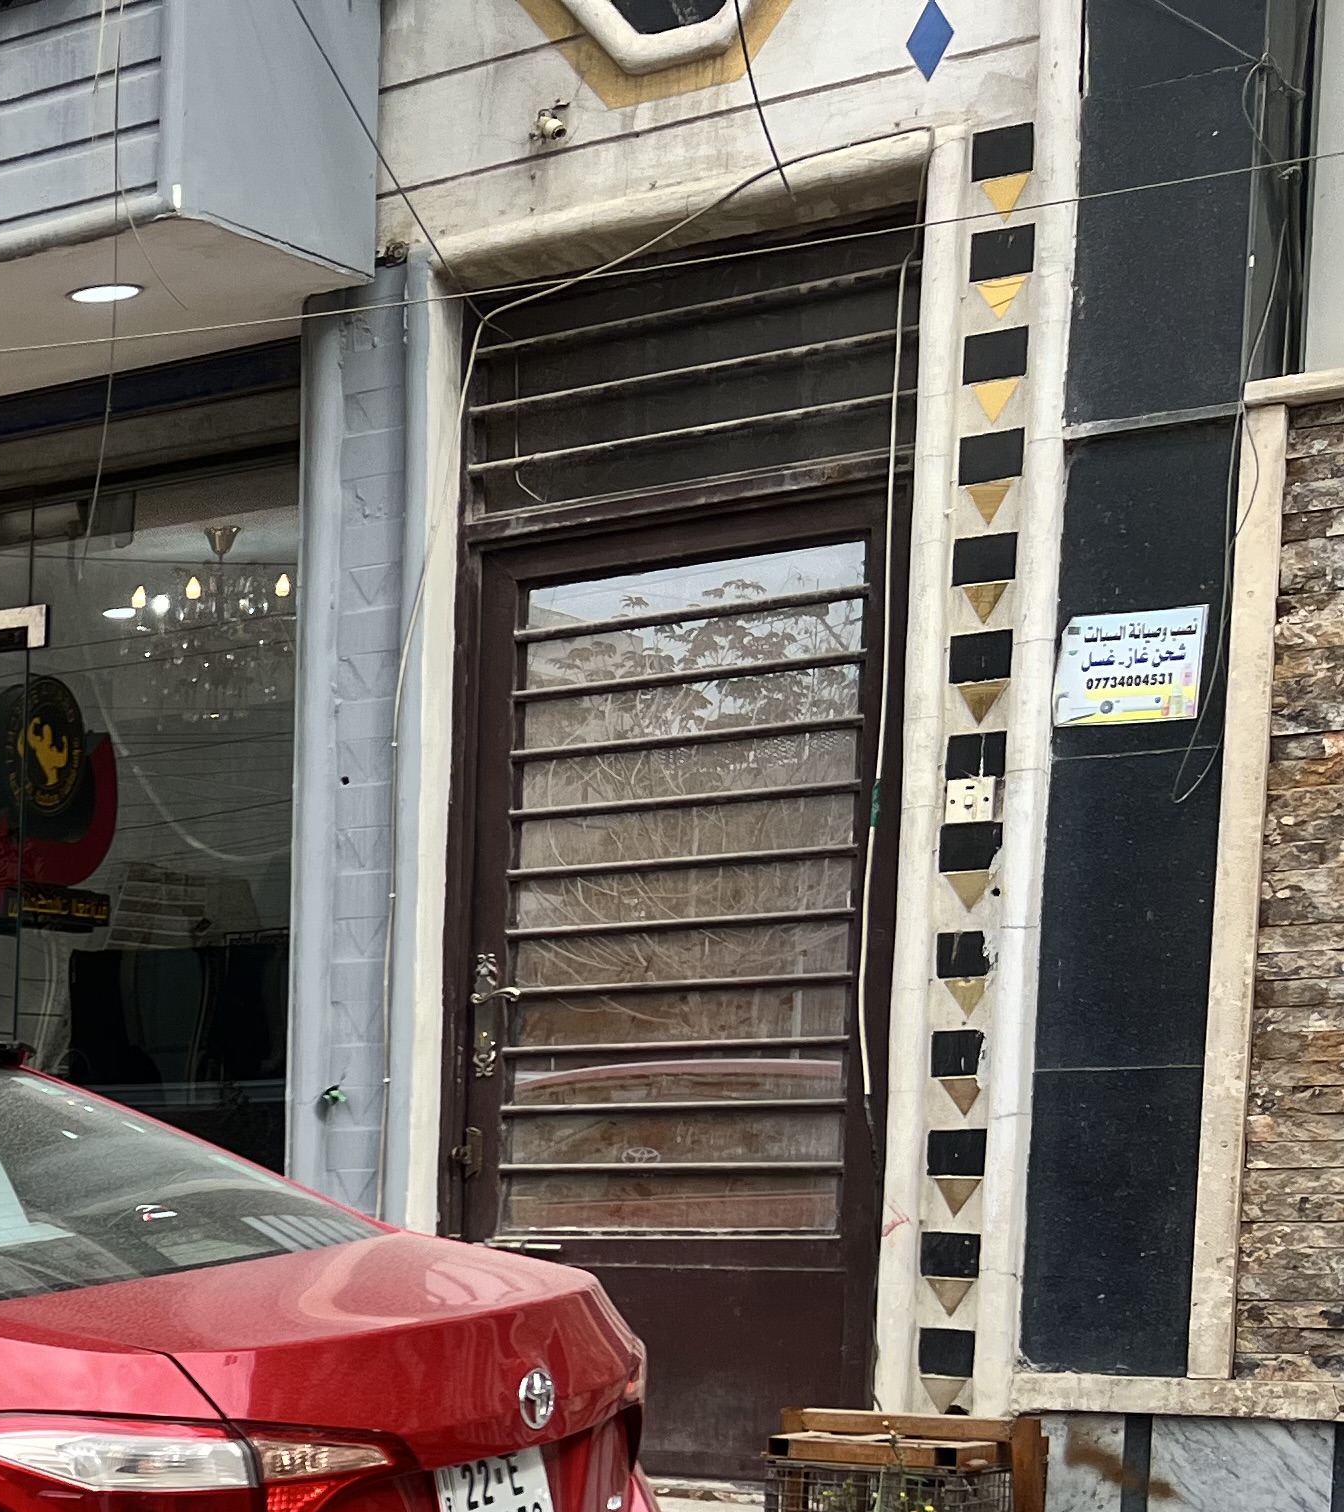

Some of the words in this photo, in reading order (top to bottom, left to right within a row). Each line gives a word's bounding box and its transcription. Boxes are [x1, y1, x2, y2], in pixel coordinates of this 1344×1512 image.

[1128, 622, 1167, 644] وصيانة
[1170, 617, 1198, 642] نصب
[1081, 649, 1116, 672] غسل
[1151, 642, 1187, 668] شحن
[1085, 672, 1174, 690] 07734004531
